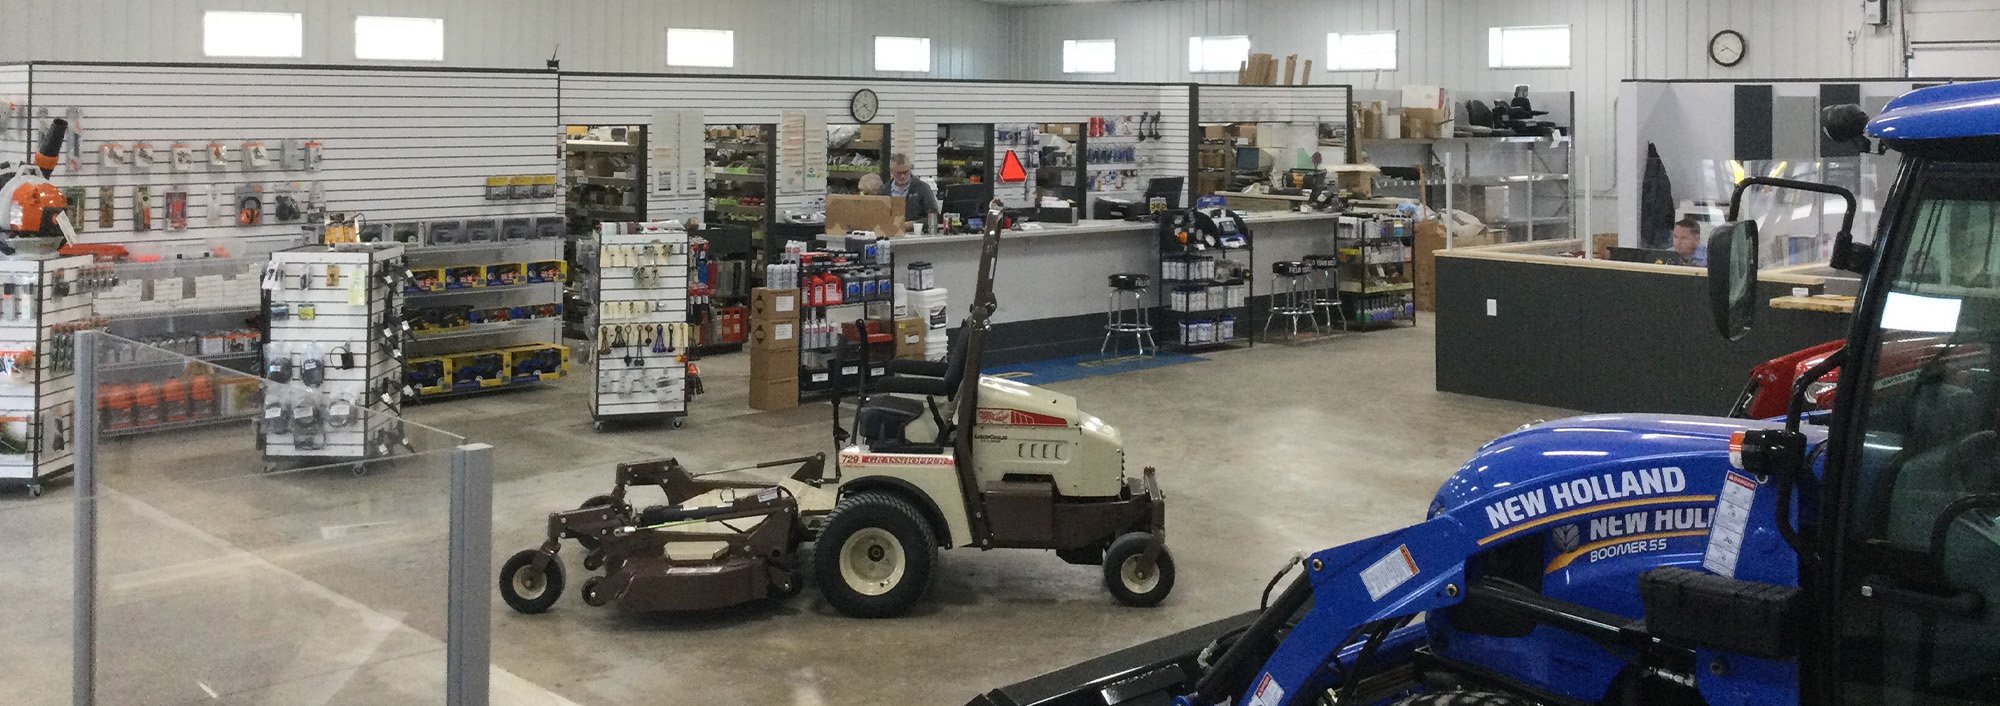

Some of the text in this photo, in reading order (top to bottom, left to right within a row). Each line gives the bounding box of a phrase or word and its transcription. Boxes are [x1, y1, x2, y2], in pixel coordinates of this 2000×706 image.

[842, 454, 945, 466] 729 GRASSHOPPER
[1485, 466, 1686, 529] NEW HOLLAND
[1590, 511, 1648, 540] NEW
[1590, 538, 1668, 563] BOOMER 55
